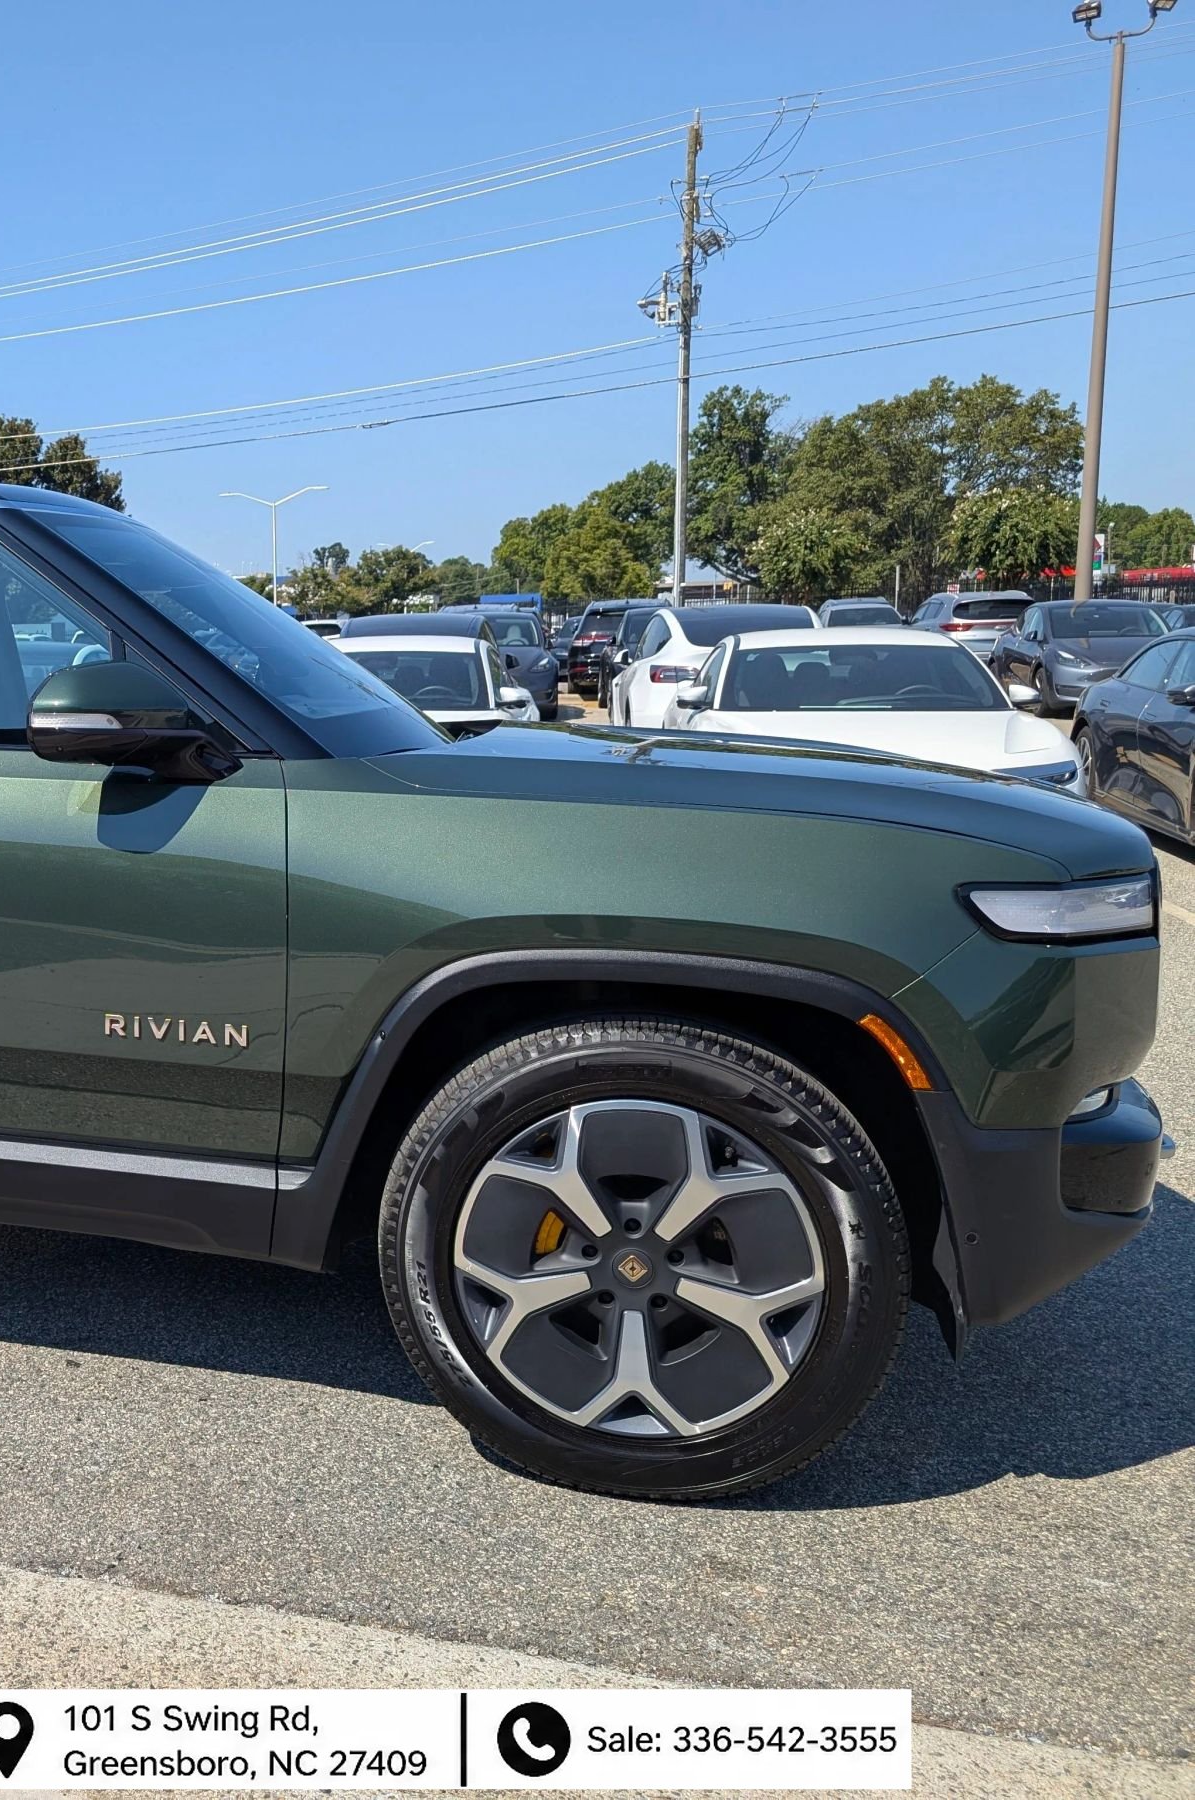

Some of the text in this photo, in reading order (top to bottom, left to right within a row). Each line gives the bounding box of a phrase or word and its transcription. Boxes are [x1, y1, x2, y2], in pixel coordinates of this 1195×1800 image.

[103, 1013, 249, 1048] RIVIAN
[415, 1260, 474, 1388] 275/55 R21
